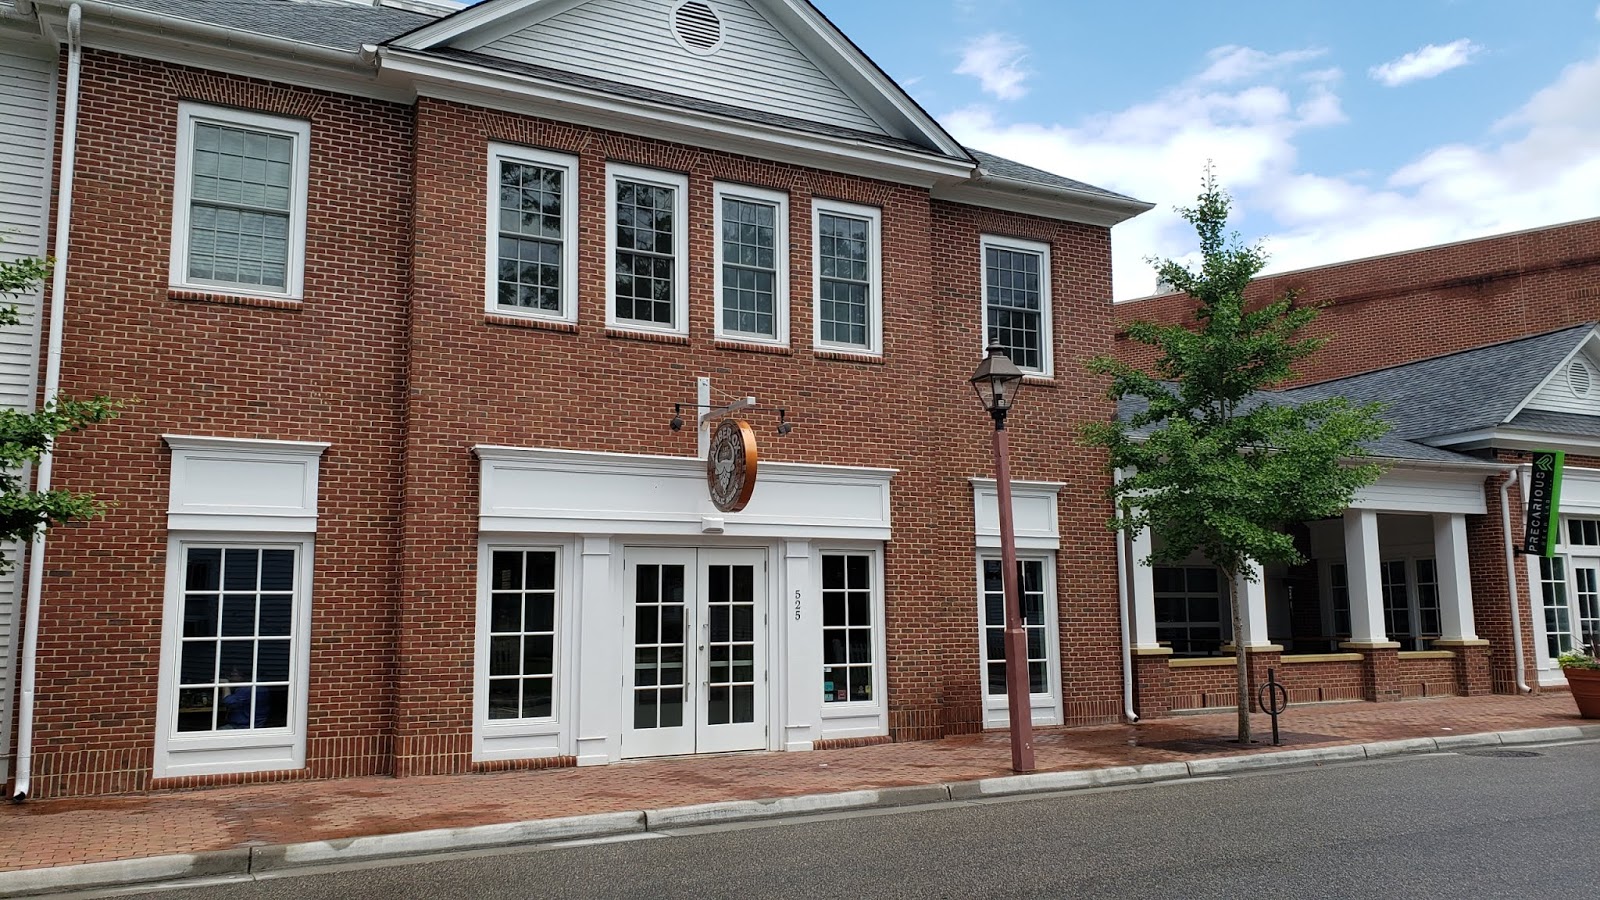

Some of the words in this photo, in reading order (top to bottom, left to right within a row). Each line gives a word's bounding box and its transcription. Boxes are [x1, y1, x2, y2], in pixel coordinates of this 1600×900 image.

[710, 427, 732, 461] AMBER
[731, 434, 741, 455] OX
[1528, 472, 1546, 552] PRECARIOUS
